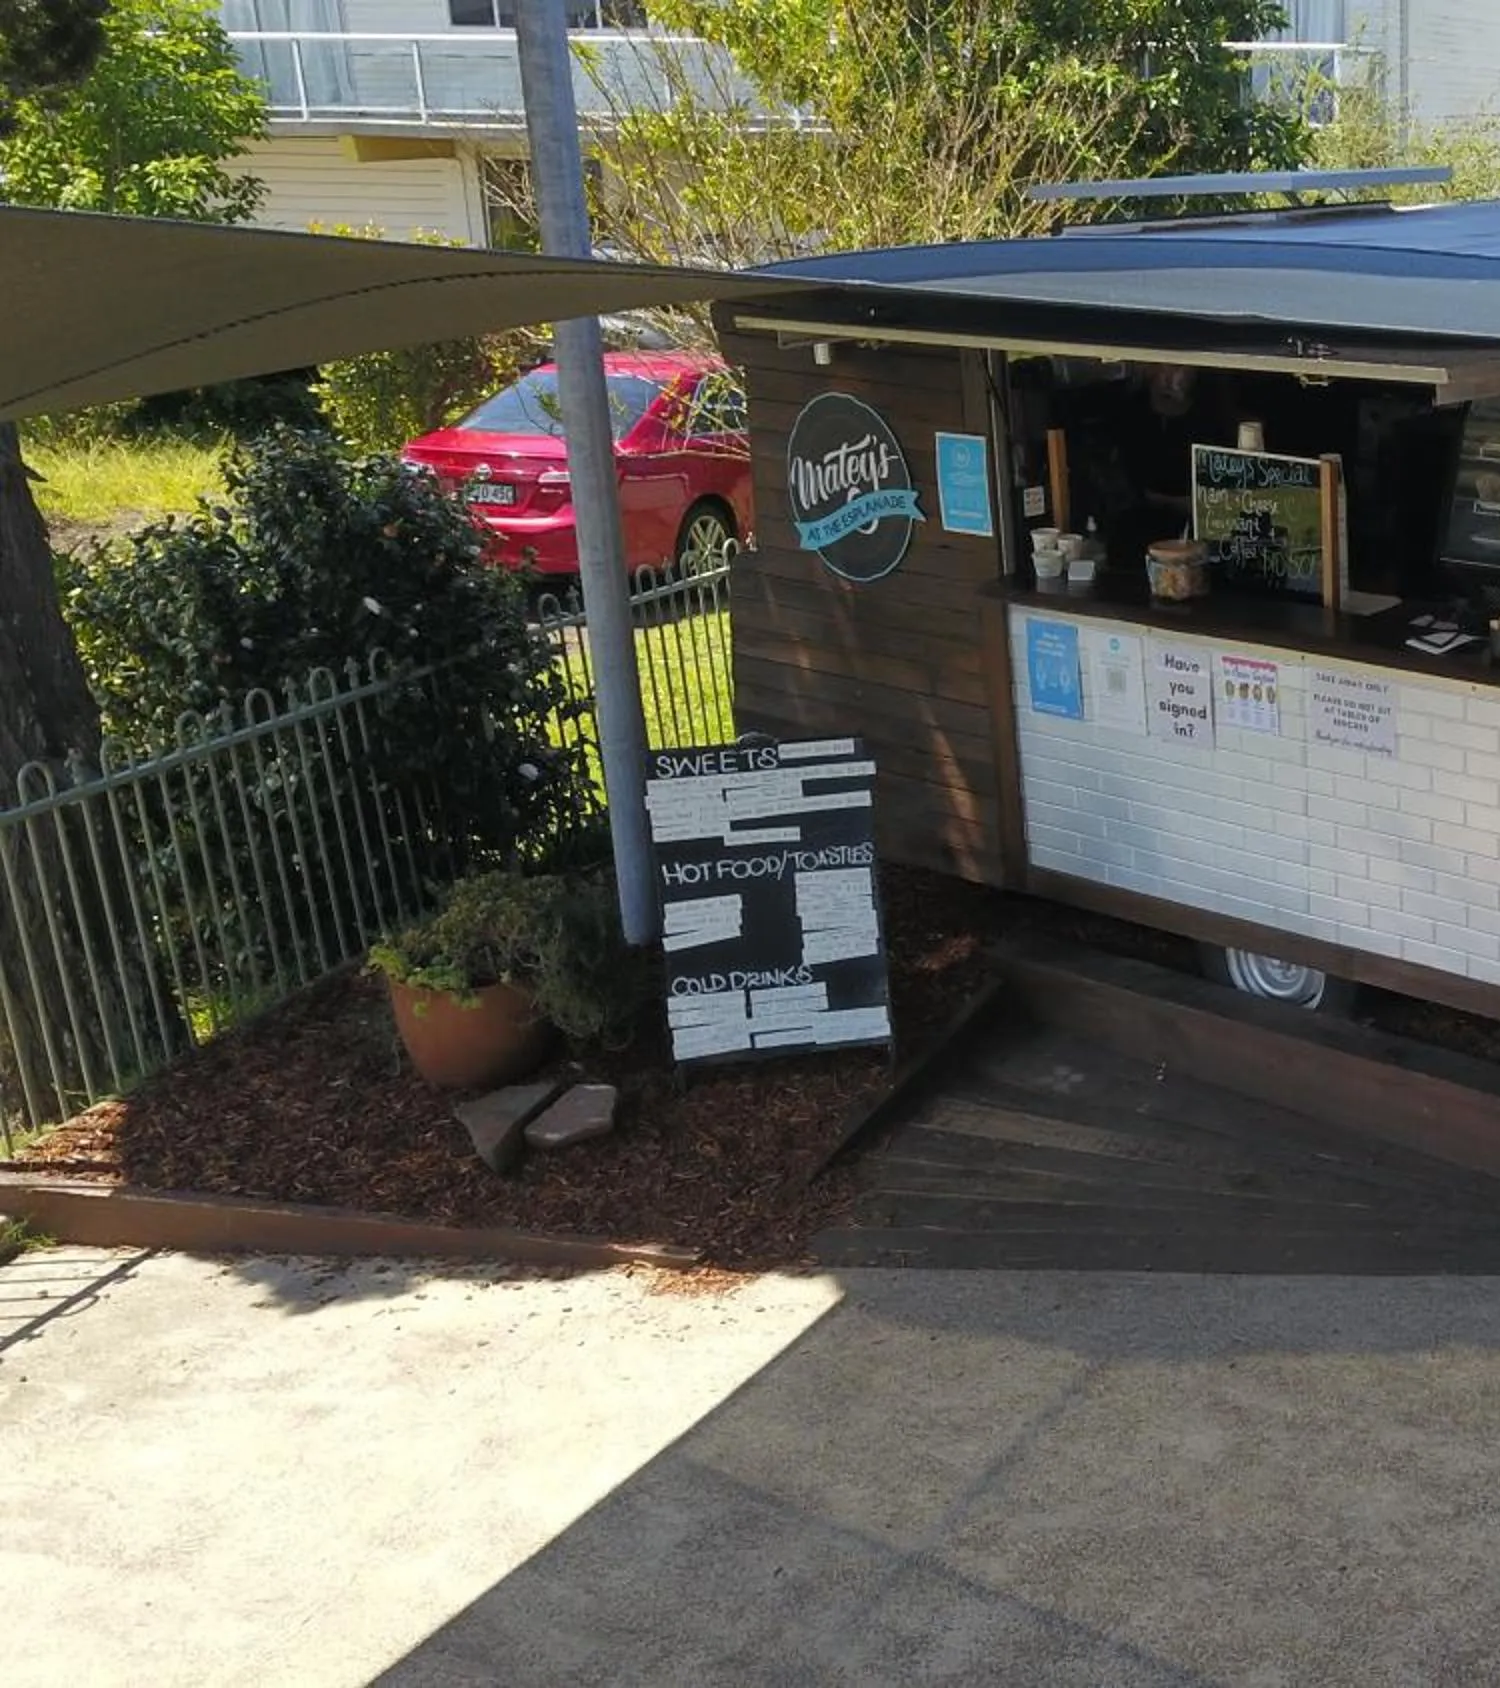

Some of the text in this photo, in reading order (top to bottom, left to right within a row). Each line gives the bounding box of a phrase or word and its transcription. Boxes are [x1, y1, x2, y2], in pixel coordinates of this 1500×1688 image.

[791, 433, 899, 511] Matey's
[841, 495, 907, 528] ESPLANADE
[1164, 653, 1201, 674] Have
[1169, 681, 1196, 696] you
[1159, 700, 1208, 721] signed
[1173, 722, 1196, 739] in?
[656, 747, 777, 779] SWEETS
[661, 862, 712, 886] HOT
[672, 974, 726, 998] COLD
[728, 965, 814, 990] DRINKS
